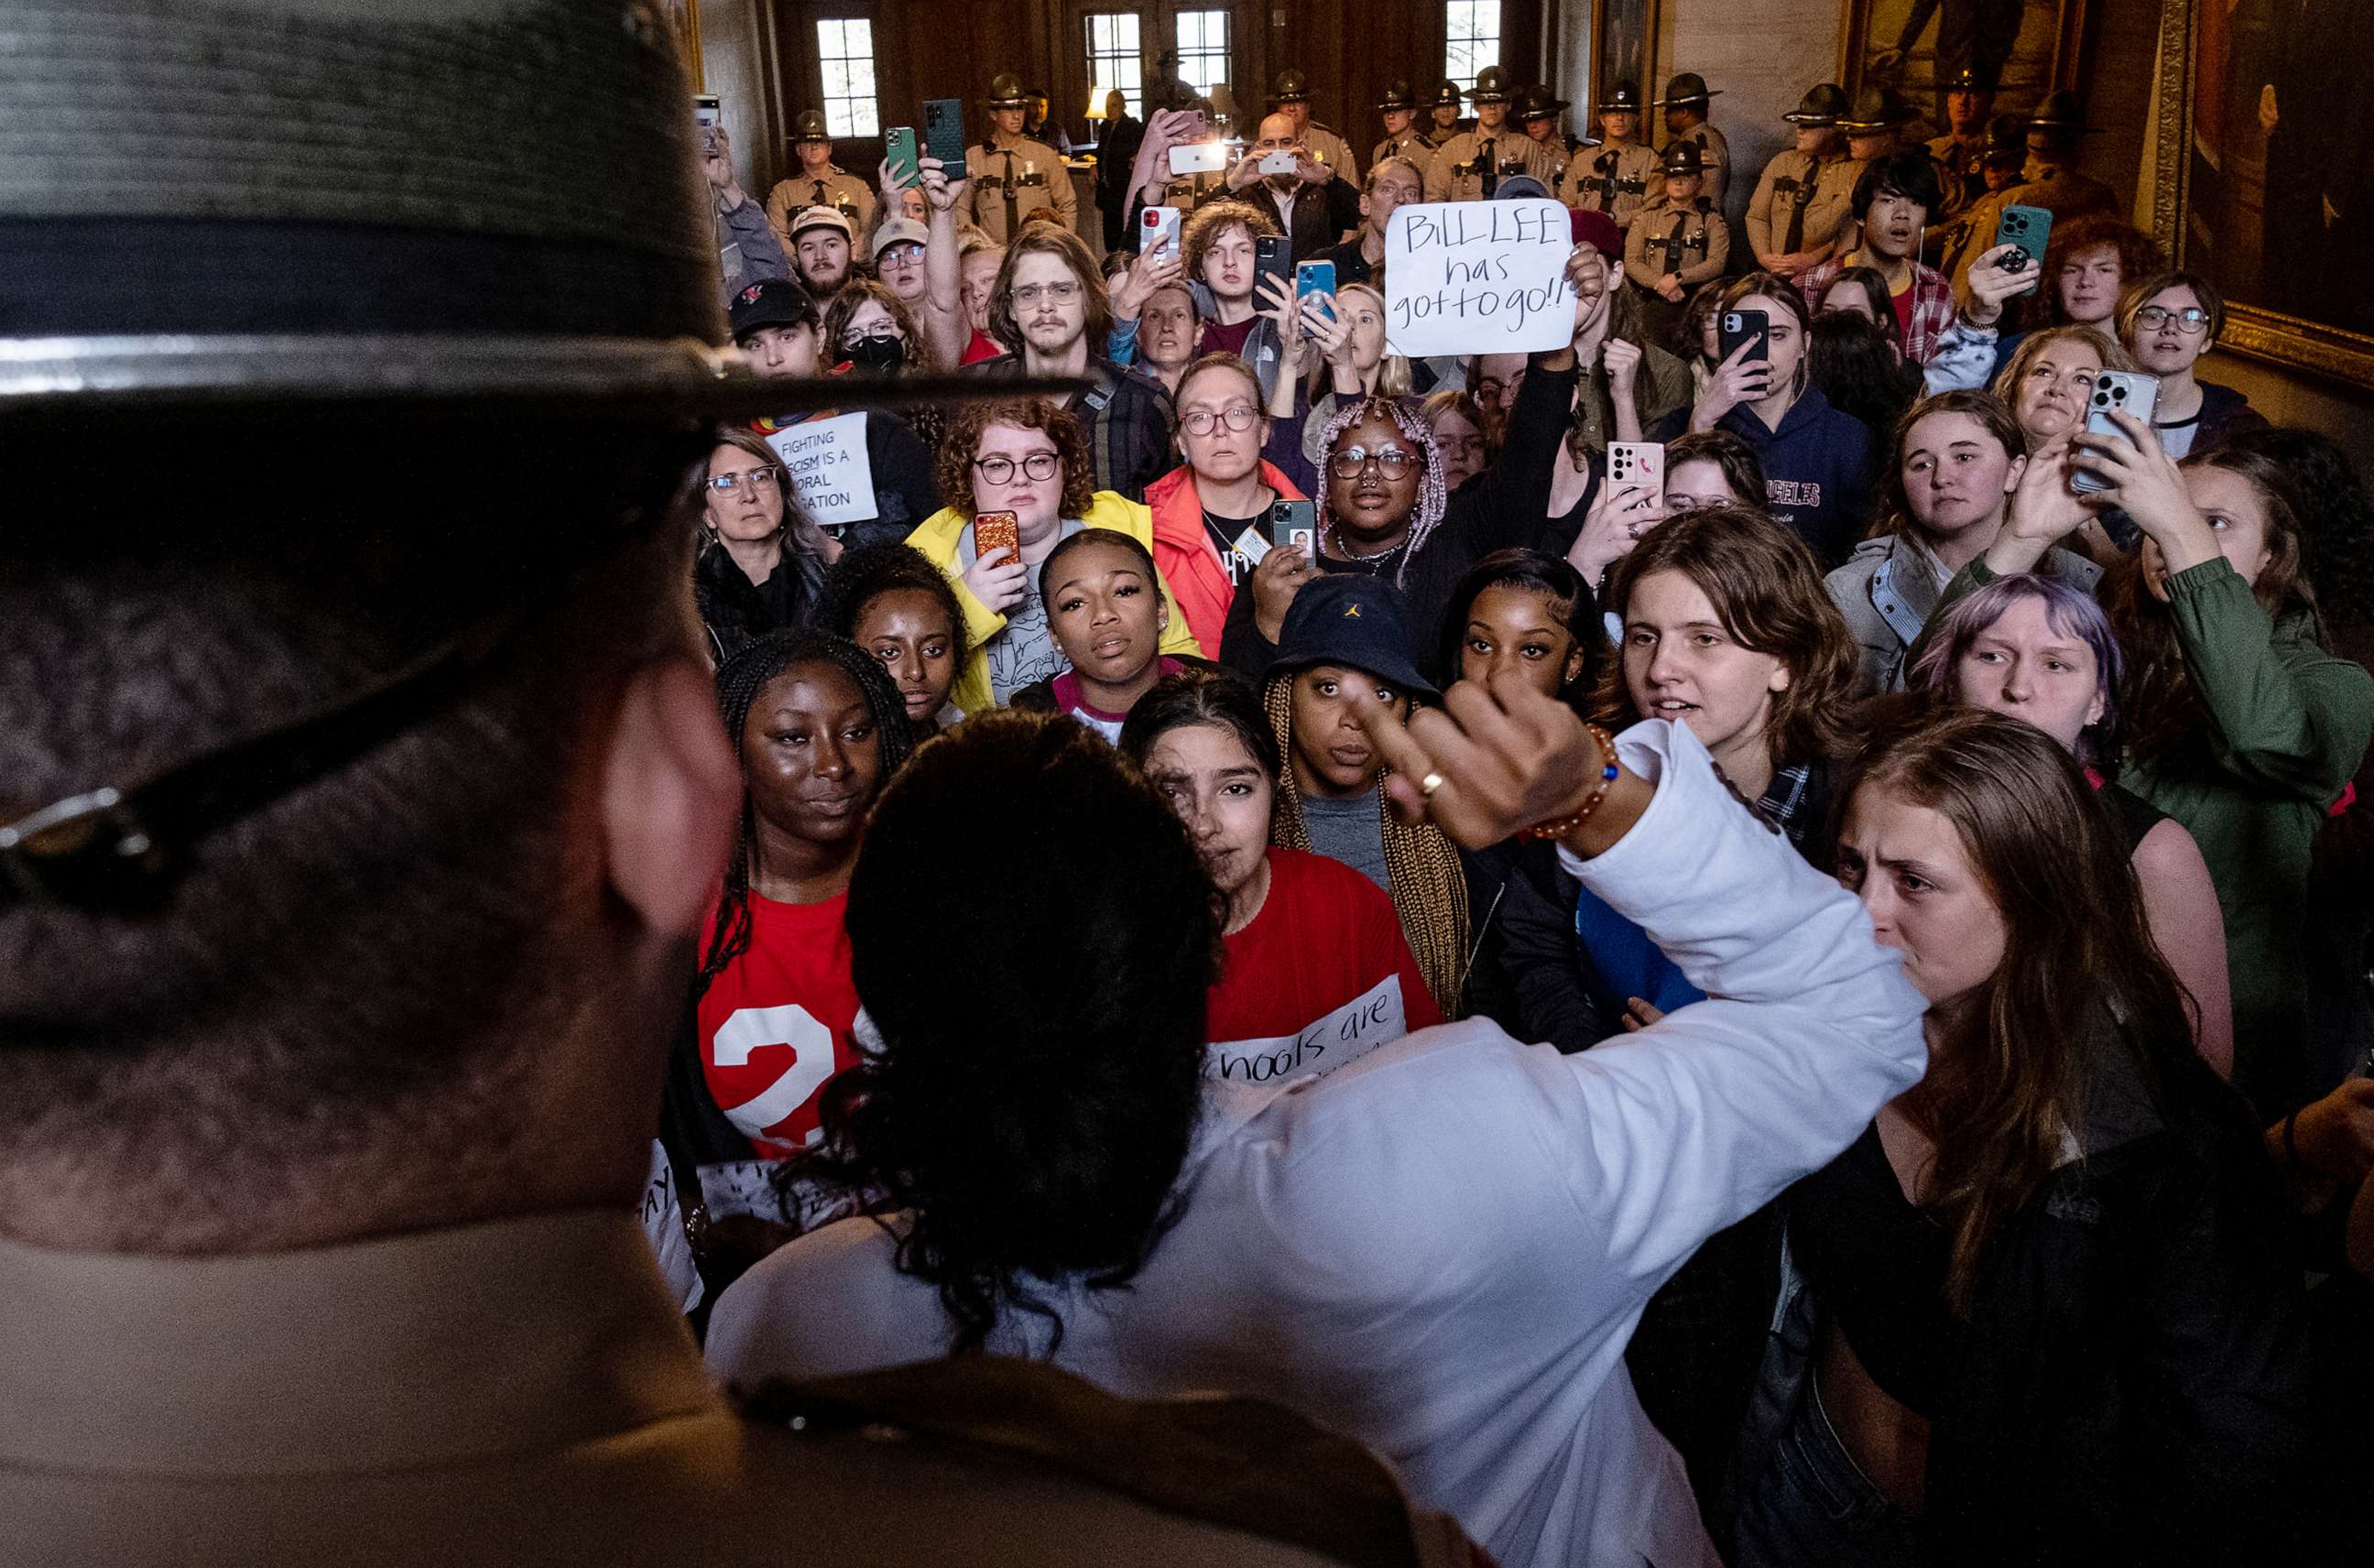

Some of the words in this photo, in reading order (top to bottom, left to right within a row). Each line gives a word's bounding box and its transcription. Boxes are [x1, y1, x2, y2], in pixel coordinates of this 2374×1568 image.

[1490, 207, 1560, 245] LEE
[1446, 253, 1511, 285] has
[1393, 289, 1450, 329] got
[1452, 289, 1499, 318] to
[1506, 278, 1564, 332] go!!
[781, 430, 834, 456] FIGHTING
[788, 455, 820, 474] SCISM
[823, 452, 835, 465] IS
[840, 450, 850, 463] A
[793, 474, 832, 491] ORAL
[1341, 995, 1388, 1041] are
[713, 1004, 888, 1148] 2
